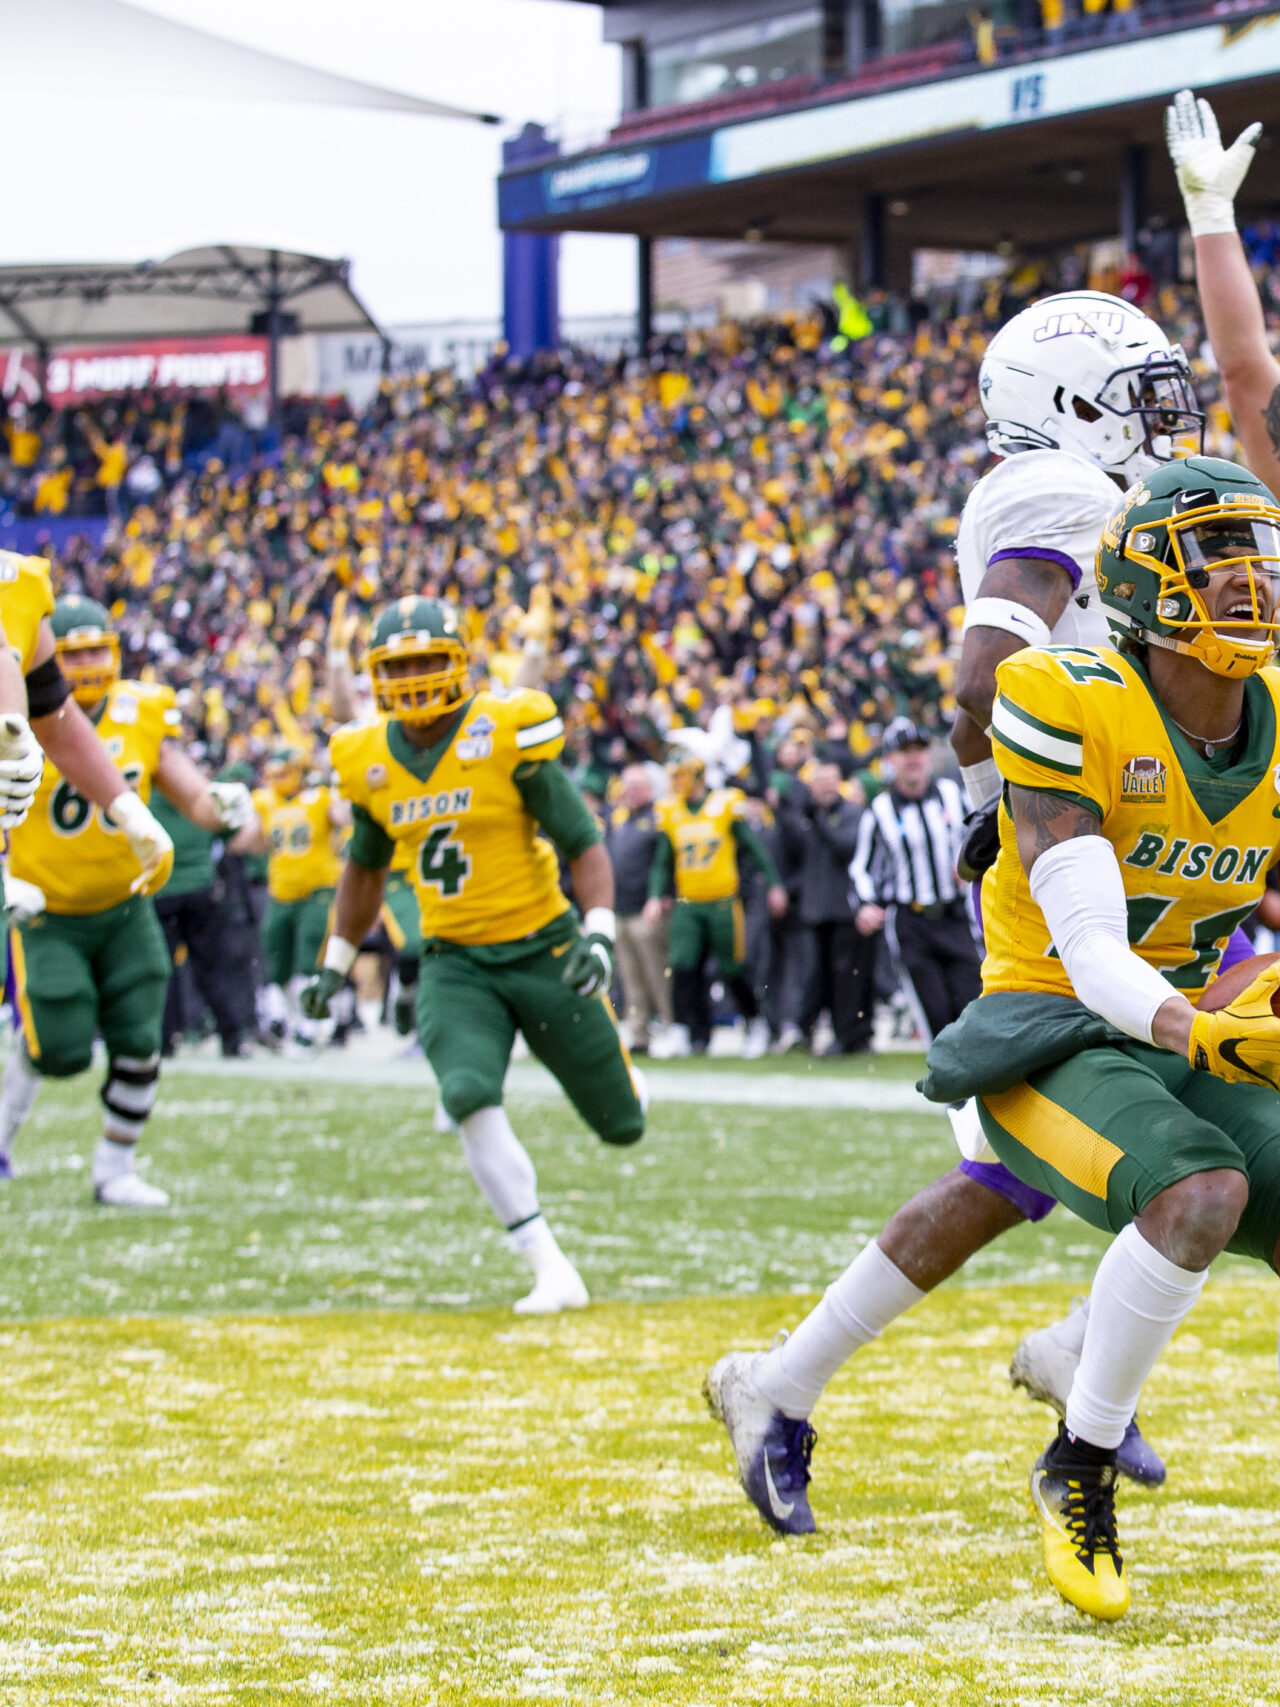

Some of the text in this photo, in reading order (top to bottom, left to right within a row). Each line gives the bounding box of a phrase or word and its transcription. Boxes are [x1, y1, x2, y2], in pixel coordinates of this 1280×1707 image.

[1033, 310, 1125, 342] JMU
[1121, 769, 1167, 794] VALLEY
[390, 788, 473, 824] BISON
[418, 821, 473, 899] 4
[1123, 831, 1272, 885] BISON
